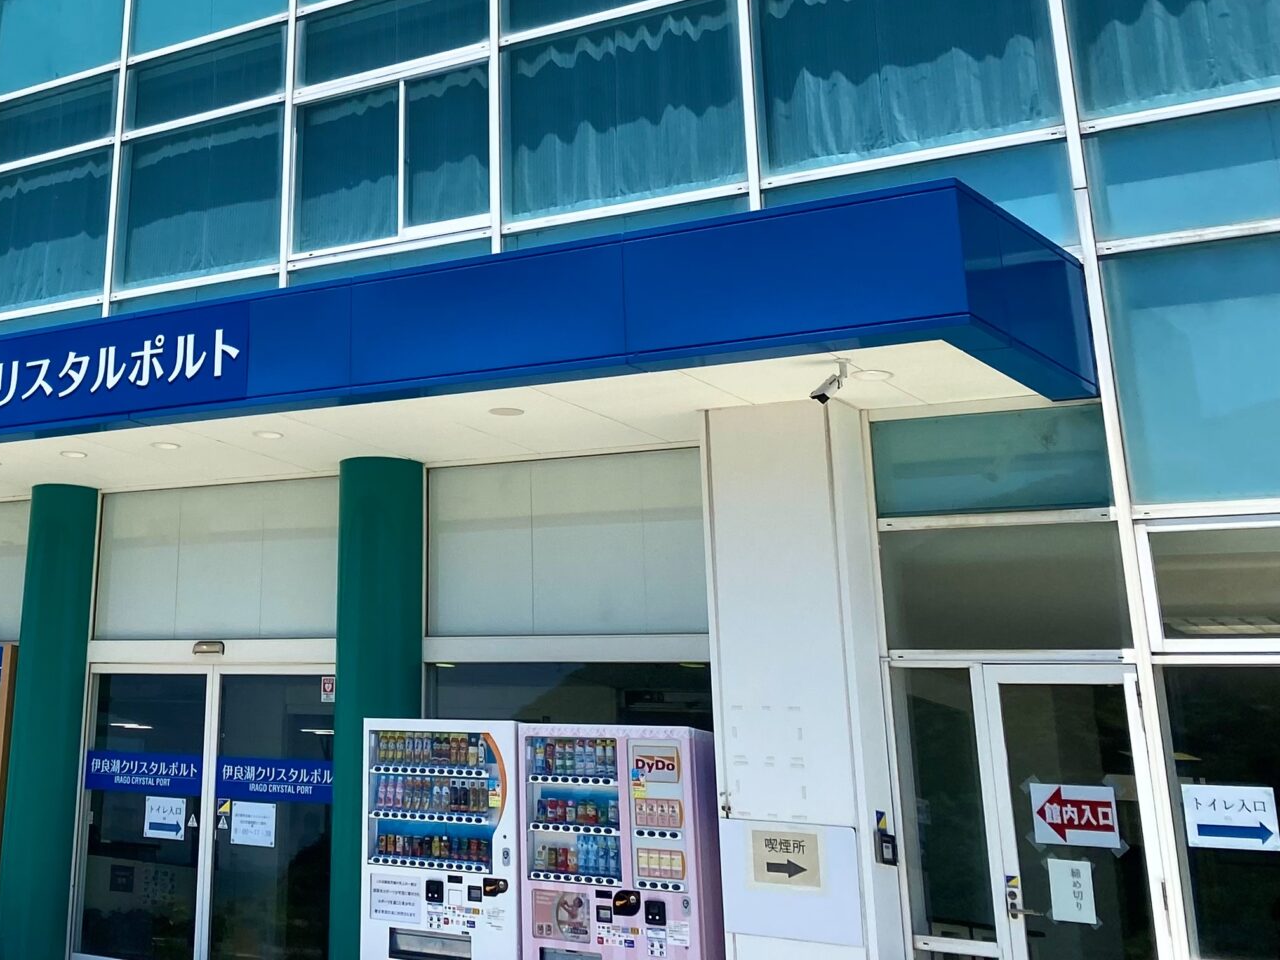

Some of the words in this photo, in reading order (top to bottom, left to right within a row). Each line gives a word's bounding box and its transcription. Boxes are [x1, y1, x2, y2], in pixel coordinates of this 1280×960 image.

[91, 758, 197, 777] 伊良湖クリスタルポルト
[635, 758, 675, 773] DyDo
[114, 776, 131, 784] IRAGO
[131, 777, 155, 786] CRYSTAL
[155, 778, 171, 787] PORT
[249, 783, 267, 792] IRAGO
[268, 784, 295, 794] CRYSTAL
[296, 785, 313, 795] PORT
[150, 805, 182, 816] トイレ入口
[1194, 797, 1266, 813] トイレ入口
[1044, 803, 1114, 826] 館内入口
[764, 837, 806, 855] 喫煙所
